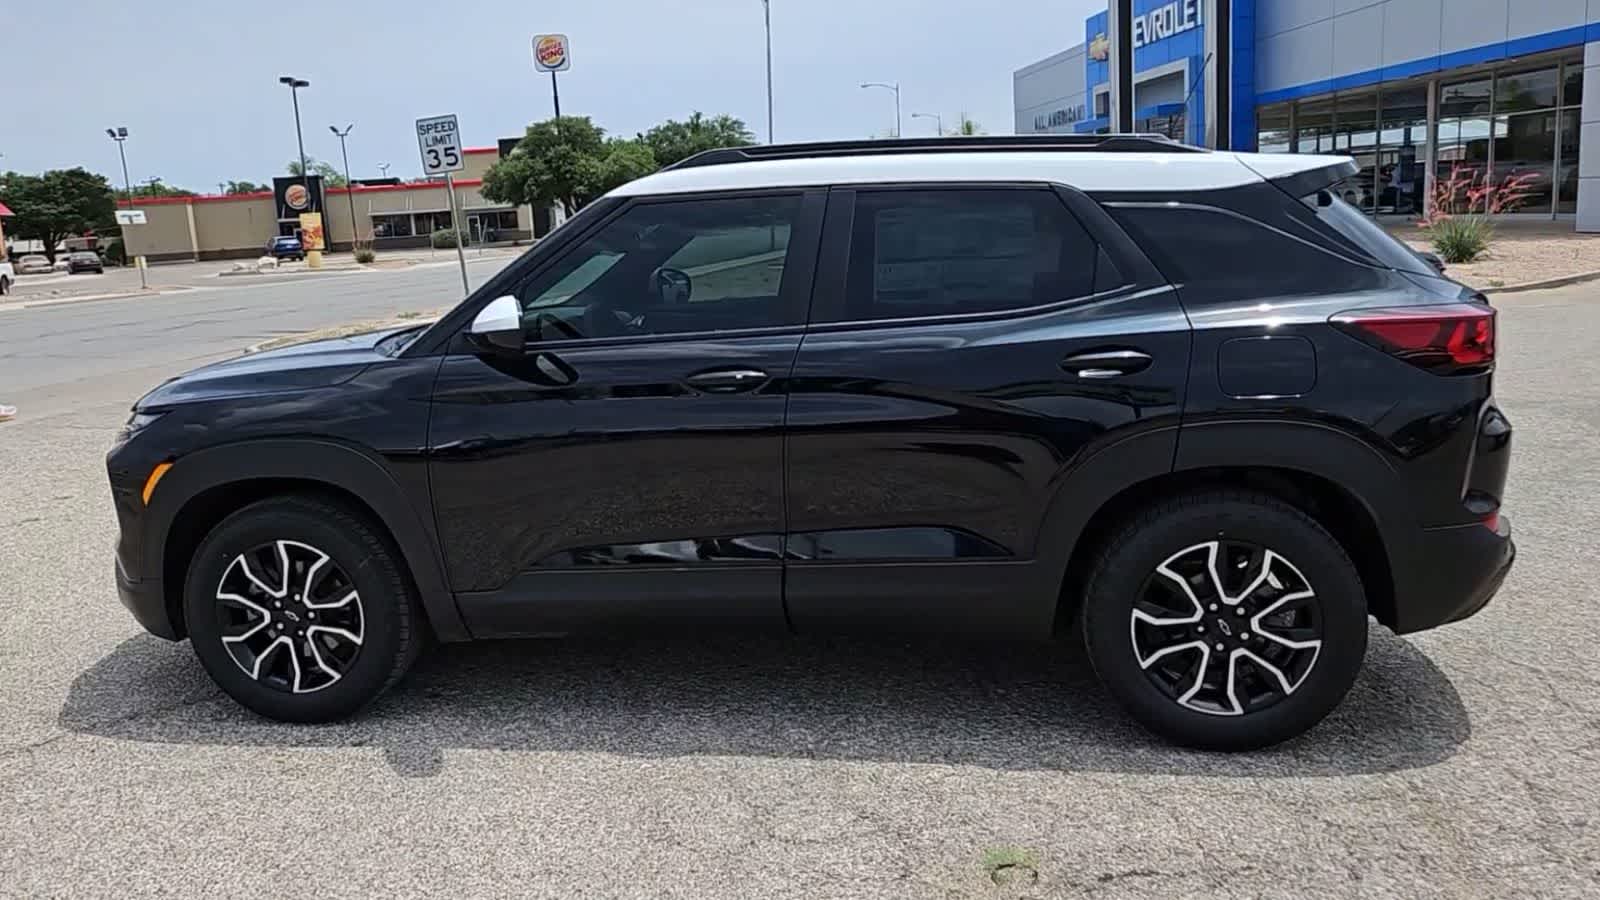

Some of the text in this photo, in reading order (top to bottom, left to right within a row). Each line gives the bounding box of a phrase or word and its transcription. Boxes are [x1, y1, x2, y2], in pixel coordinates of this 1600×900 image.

[540, 48, 564, 61] KING
[419, 120, 456, 135] SPEED
[425, 133, 453, 147] LIMIT
[427, 146, 459, 168] 35
